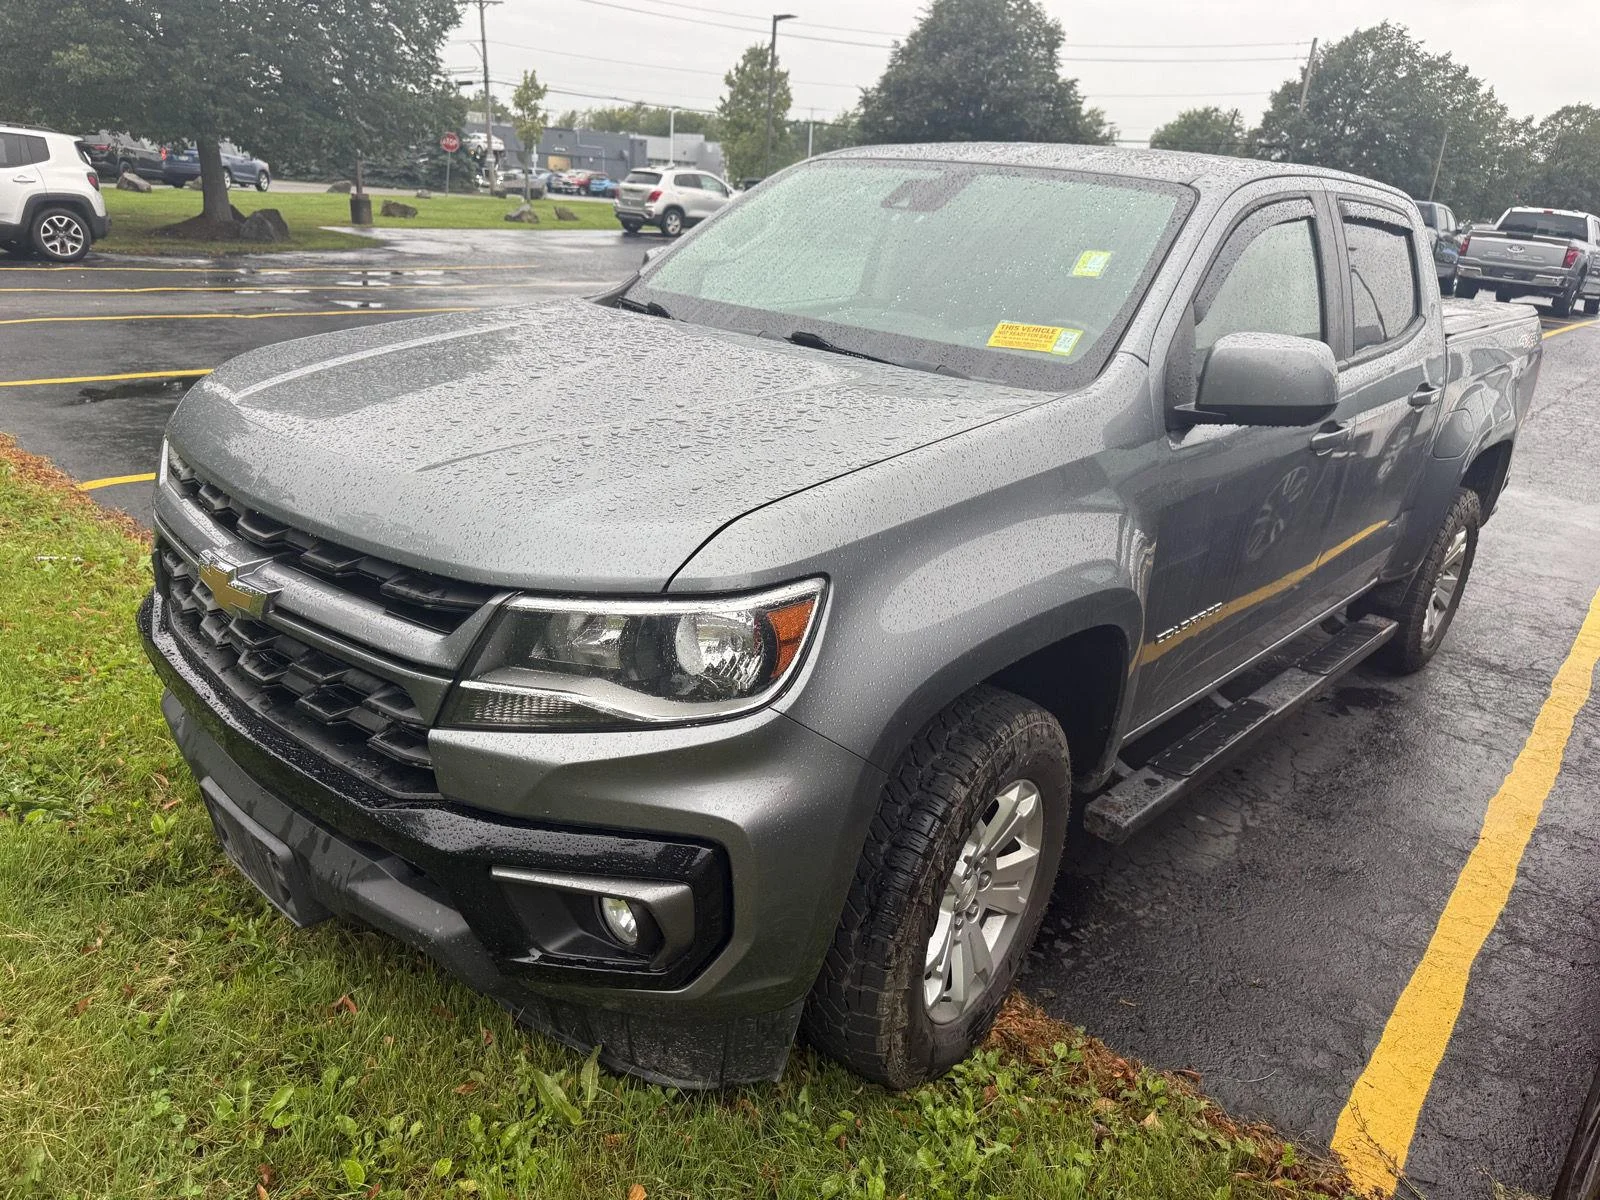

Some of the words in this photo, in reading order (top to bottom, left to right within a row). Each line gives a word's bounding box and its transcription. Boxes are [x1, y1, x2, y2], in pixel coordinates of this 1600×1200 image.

[442, 137, 458, 145] STOP
[1022, 326, 1057, 334] VEHICLE
[1157, 602, 1222, 643] COLORADO
